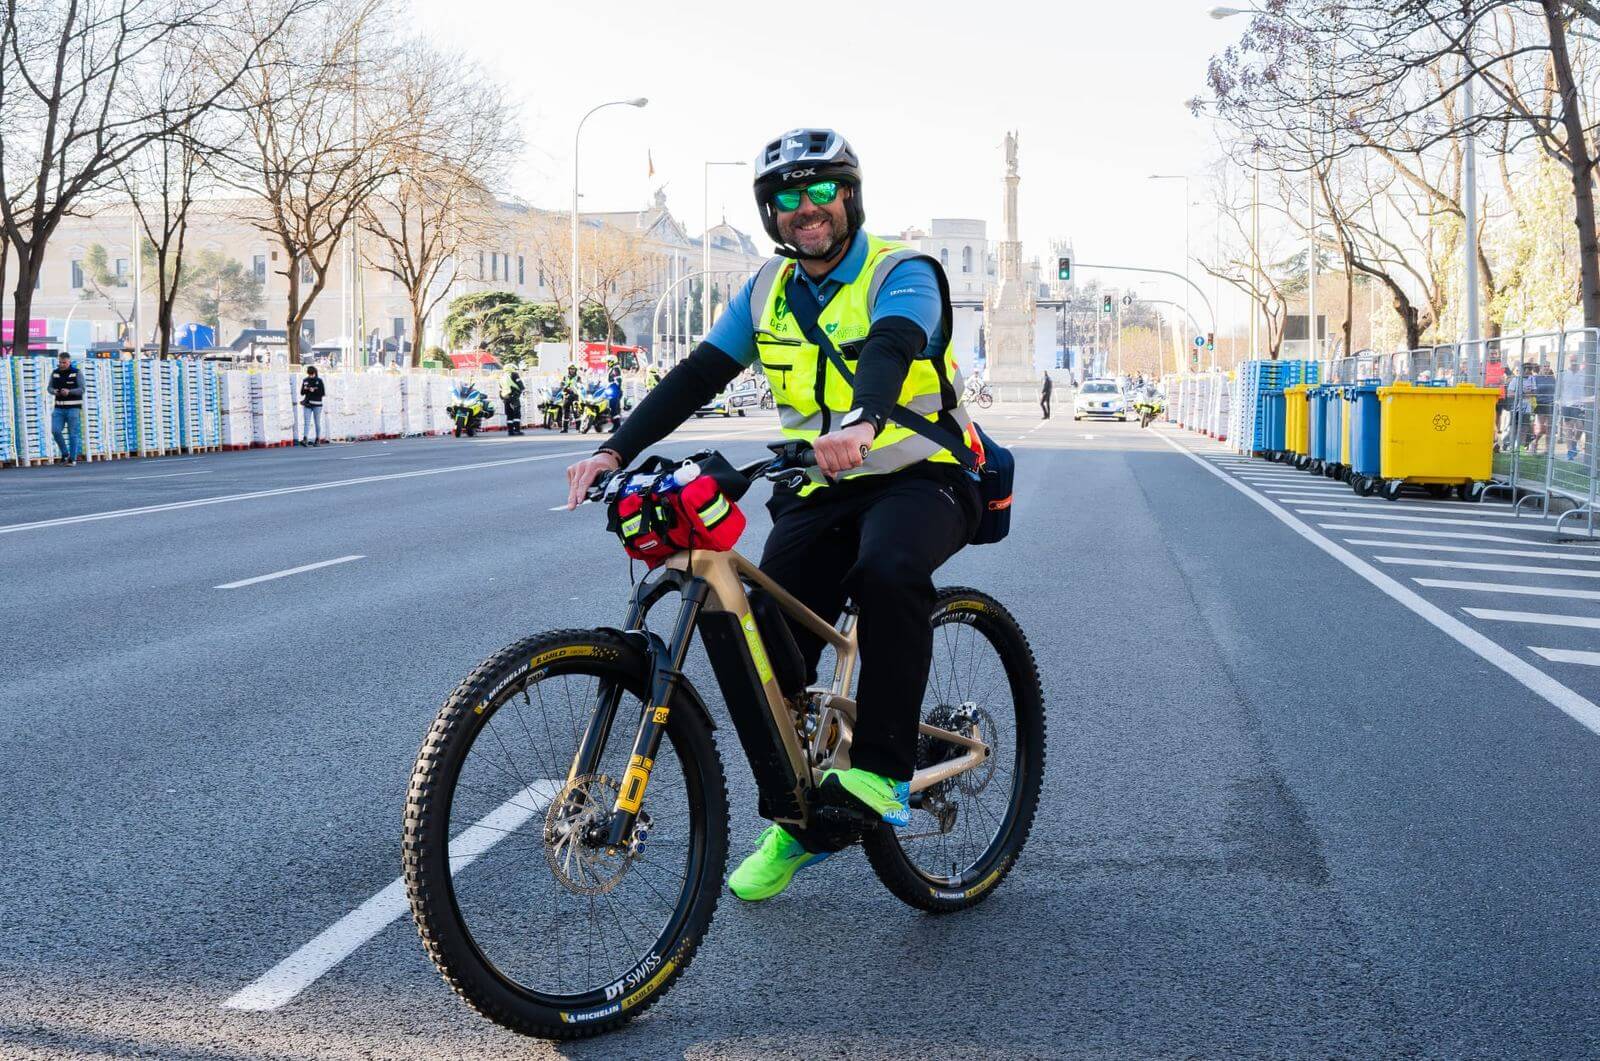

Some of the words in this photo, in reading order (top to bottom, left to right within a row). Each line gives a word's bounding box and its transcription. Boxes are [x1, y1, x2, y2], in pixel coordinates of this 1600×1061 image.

[783, 168, 817, 181] FOX
[489, 663, 528, 700] MICHELIN
[655, 711, 669, 723] 38
[604, 980, 625, 1001] DT
[625, 951, 661, 988] SWISS
[577, 1004, 620, 1022] MICHELIN
